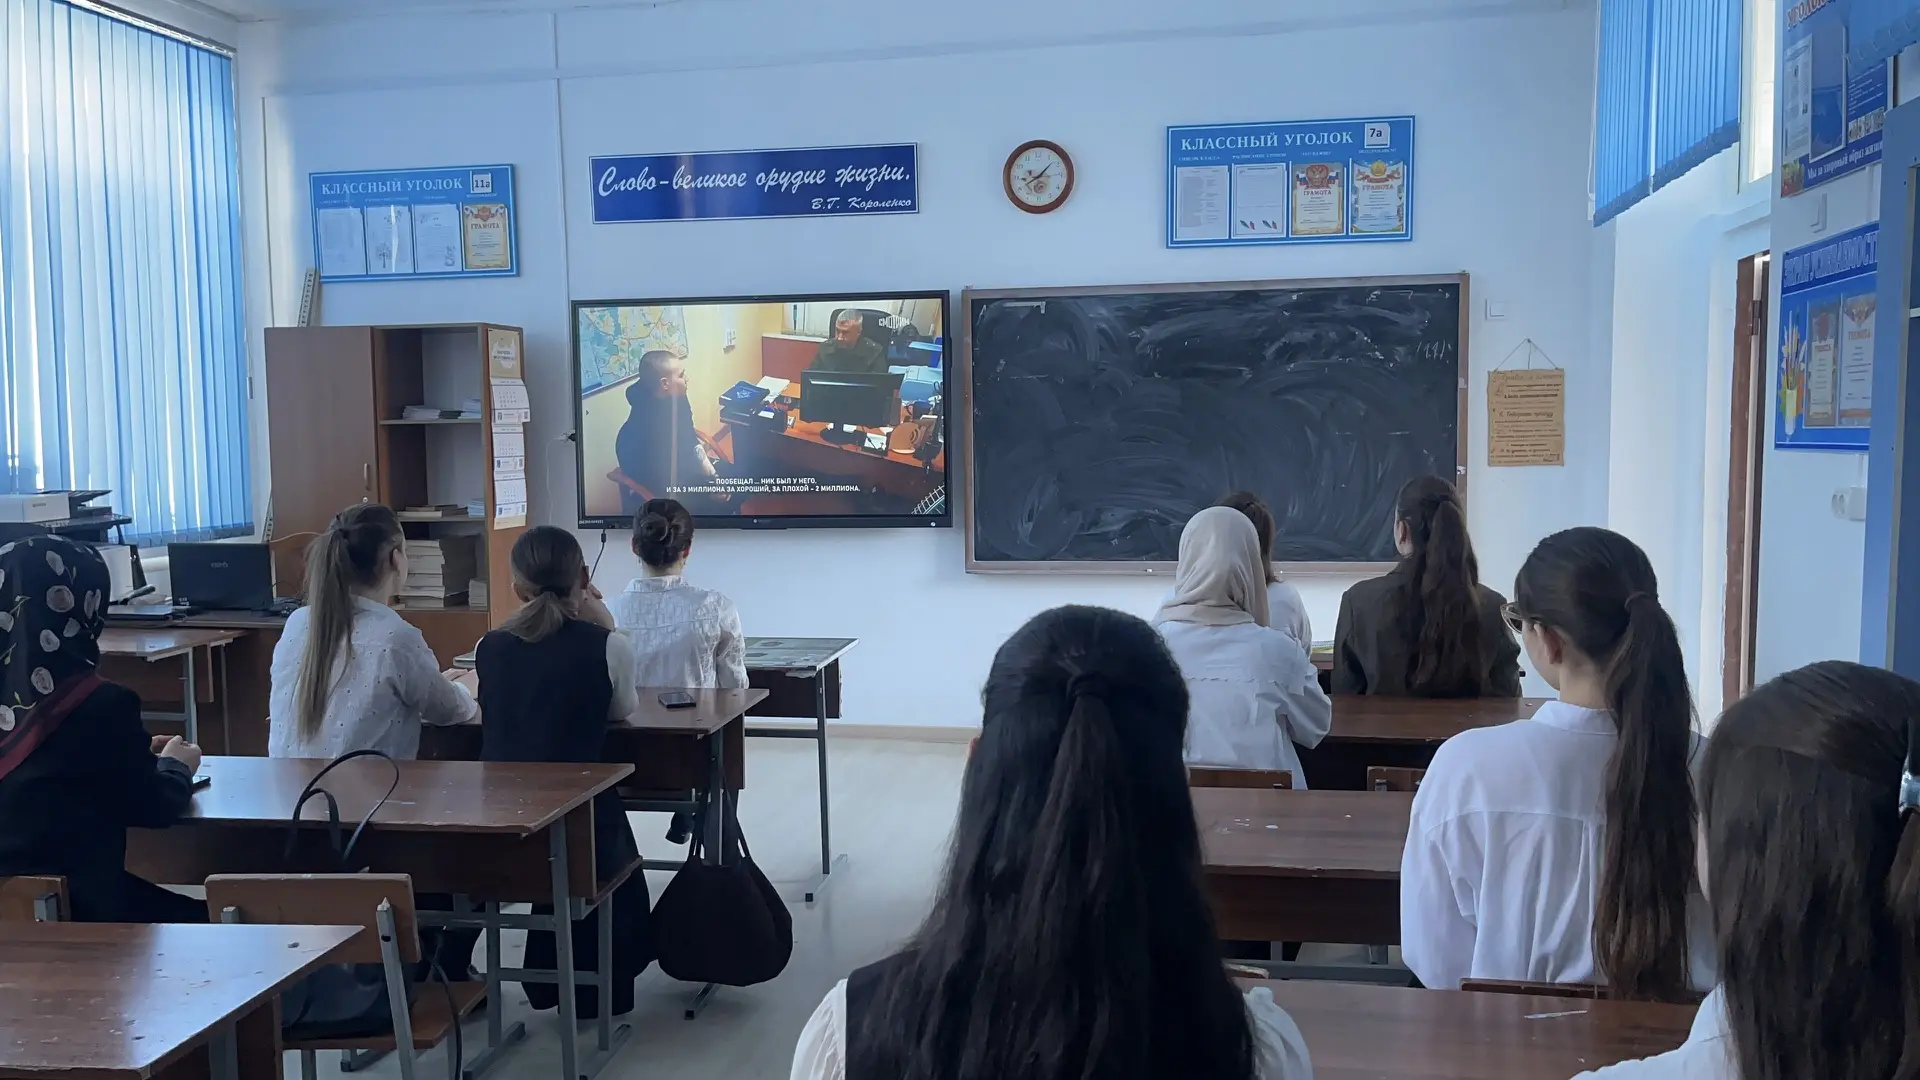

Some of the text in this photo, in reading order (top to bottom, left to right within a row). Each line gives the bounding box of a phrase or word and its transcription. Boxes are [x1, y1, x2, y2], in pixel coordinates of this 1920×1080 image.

[1369, 127, 1383, 138] 7а
[1180, 131, 1354, 151] КЛАССНЫЙ УГОЛОК
[755, 168, 826, 193] орудие
[834, 163, 910, 191] жизни.
[321, 177, 463, 195] КЛАССНЫЙ УГОЛОК
[474, 179, 490, 189] 11а
[847, 197, 912, 211] Короленко
[471, 222, 500, 230] ГРАМОТА
[715, 478, 754, 486] ПООБЕЩАЛ
[798, 477, 817, 485] НЕГО.
[736, 484, 771, 493] ХОРОШИЙ,
[781, 484, 810, 493] ПЛОХОЙ
